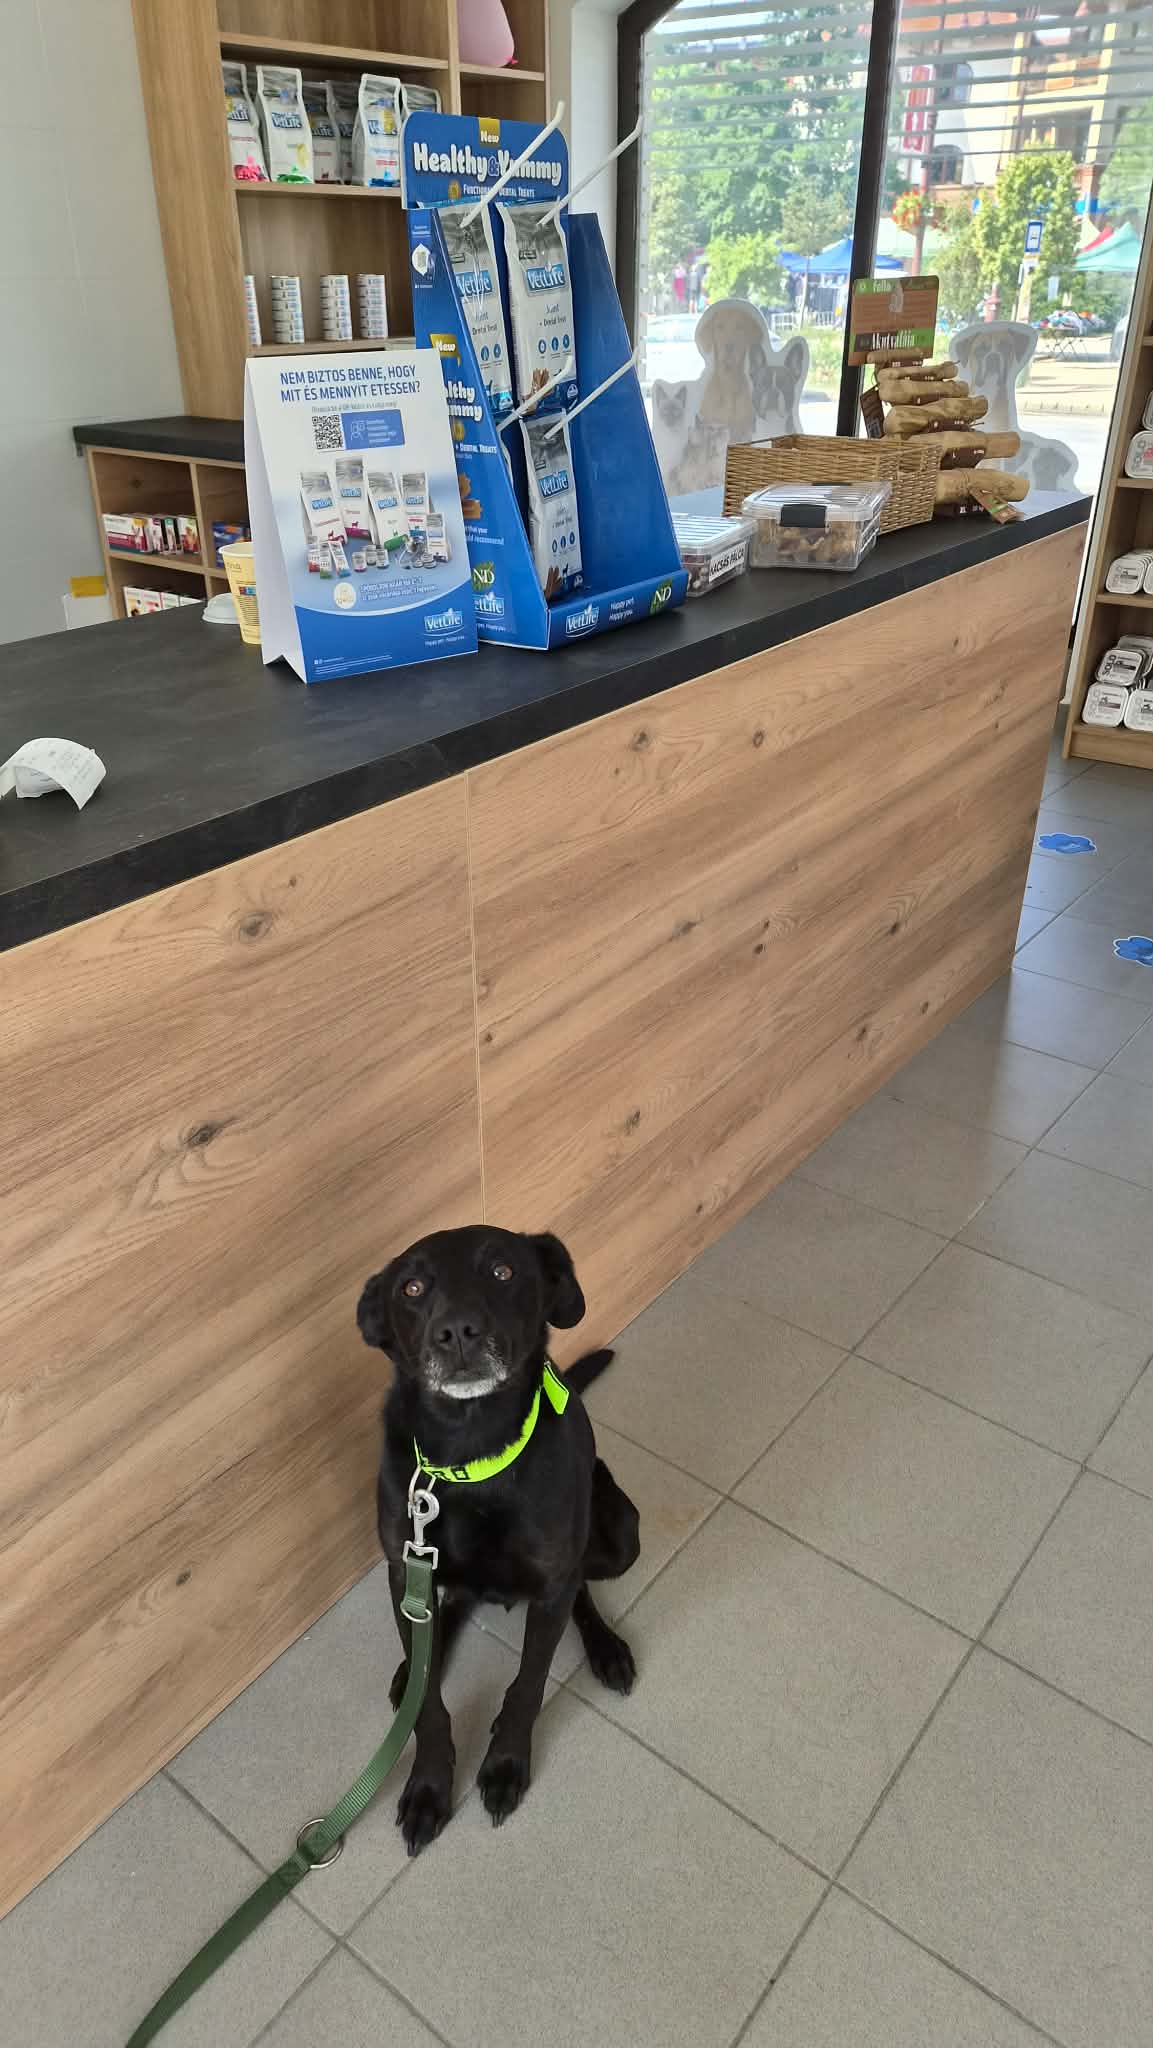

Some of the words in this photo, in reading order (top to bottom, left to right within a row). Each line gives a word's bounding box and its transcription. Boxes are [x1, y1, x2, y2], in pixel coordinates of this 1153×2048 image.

[480, 130, 500, 144] New
[413, 142, 488, 182] Healthy
[528, 269, 566, 290] VetLife
[435, 341, 456, 353] New
[280, 371, 306, 385] NEM
[307, 368, 346, 384] BIZTOS
[349, 366, 387, 382] BENNE,
[388, 365, 416, 379] HOGY
[280, 388, 303, 403] MIT
[304, 385, 317, 401] ÉS
[319, 384, 369, 400] MENNYIT
[371, 381, 421, 396] ETESSEN?
[473, 567, 495, 584] ND
[653, 585, 672, 604] ND
[474, 598, 503, 614] etLife
[427, 614, 461, 630] VetLife
[567, 611, 598, 632] VetLife
[1102, 654, 1117, 677] SOLO
